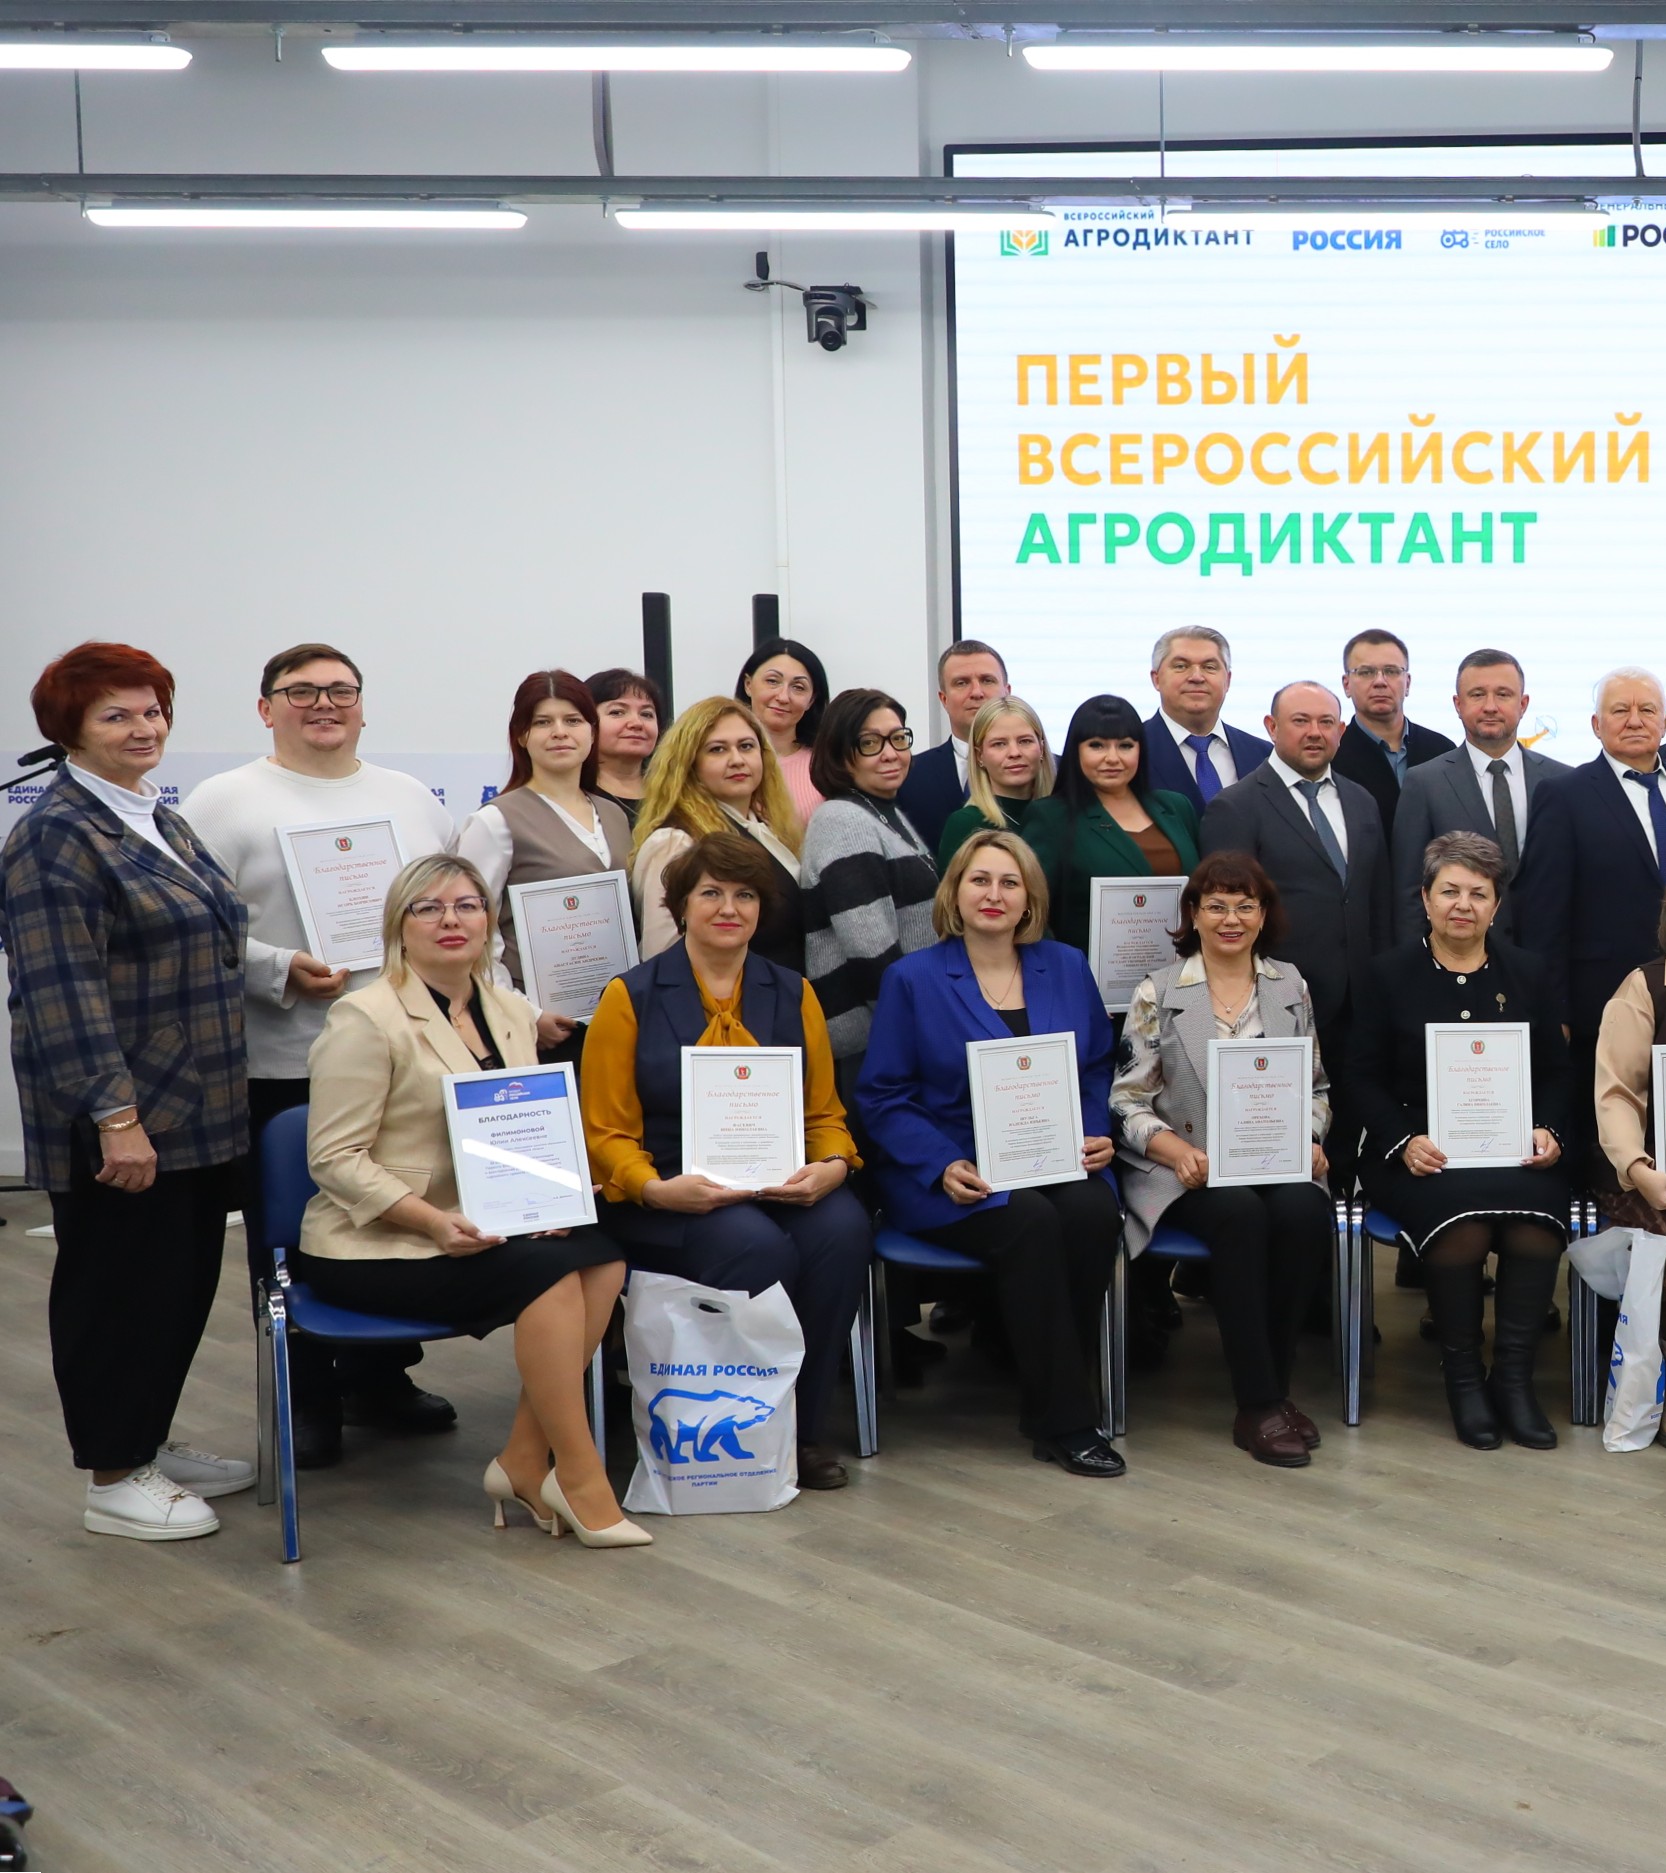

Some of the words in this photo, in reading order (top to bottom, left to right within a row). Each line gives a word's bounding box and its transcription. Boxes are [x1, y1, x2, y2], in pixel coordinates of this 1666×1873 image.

[1064, 210, 1155, 221] ВСЕРОССИЙСКИЙ
[1064, 228, 1255, 250] АГРОДИКТАНТ
[1292, 229, 1402, 250] РОССИЯ
[1485, 239, 1510, 249] СЕЛО
[1016, 334, 1309, 406] ПЕРВЫЙ
[1016, 411, 1651, 486] ВСЕРОССИЙСКИЙ
[1016, 511, 1538, 576] АГРОДИКТАНТ
[7, 786, 46, 794] ЕДИНА
[8, 795, 38, 804] РОСС
[478, 1109, 552, 1124] БЛАГОДАРНОСТЬ
[491, 1126, 545, 1138] ФИЛИМОНОВОЙ
[650, 1363, 707, 1376] ЕДИНАЯ
[713, 1365, 778, 1377] РОССИЯ
[687, 1472, 737, 1480] РЕГИОНАЛЬНОЕ
